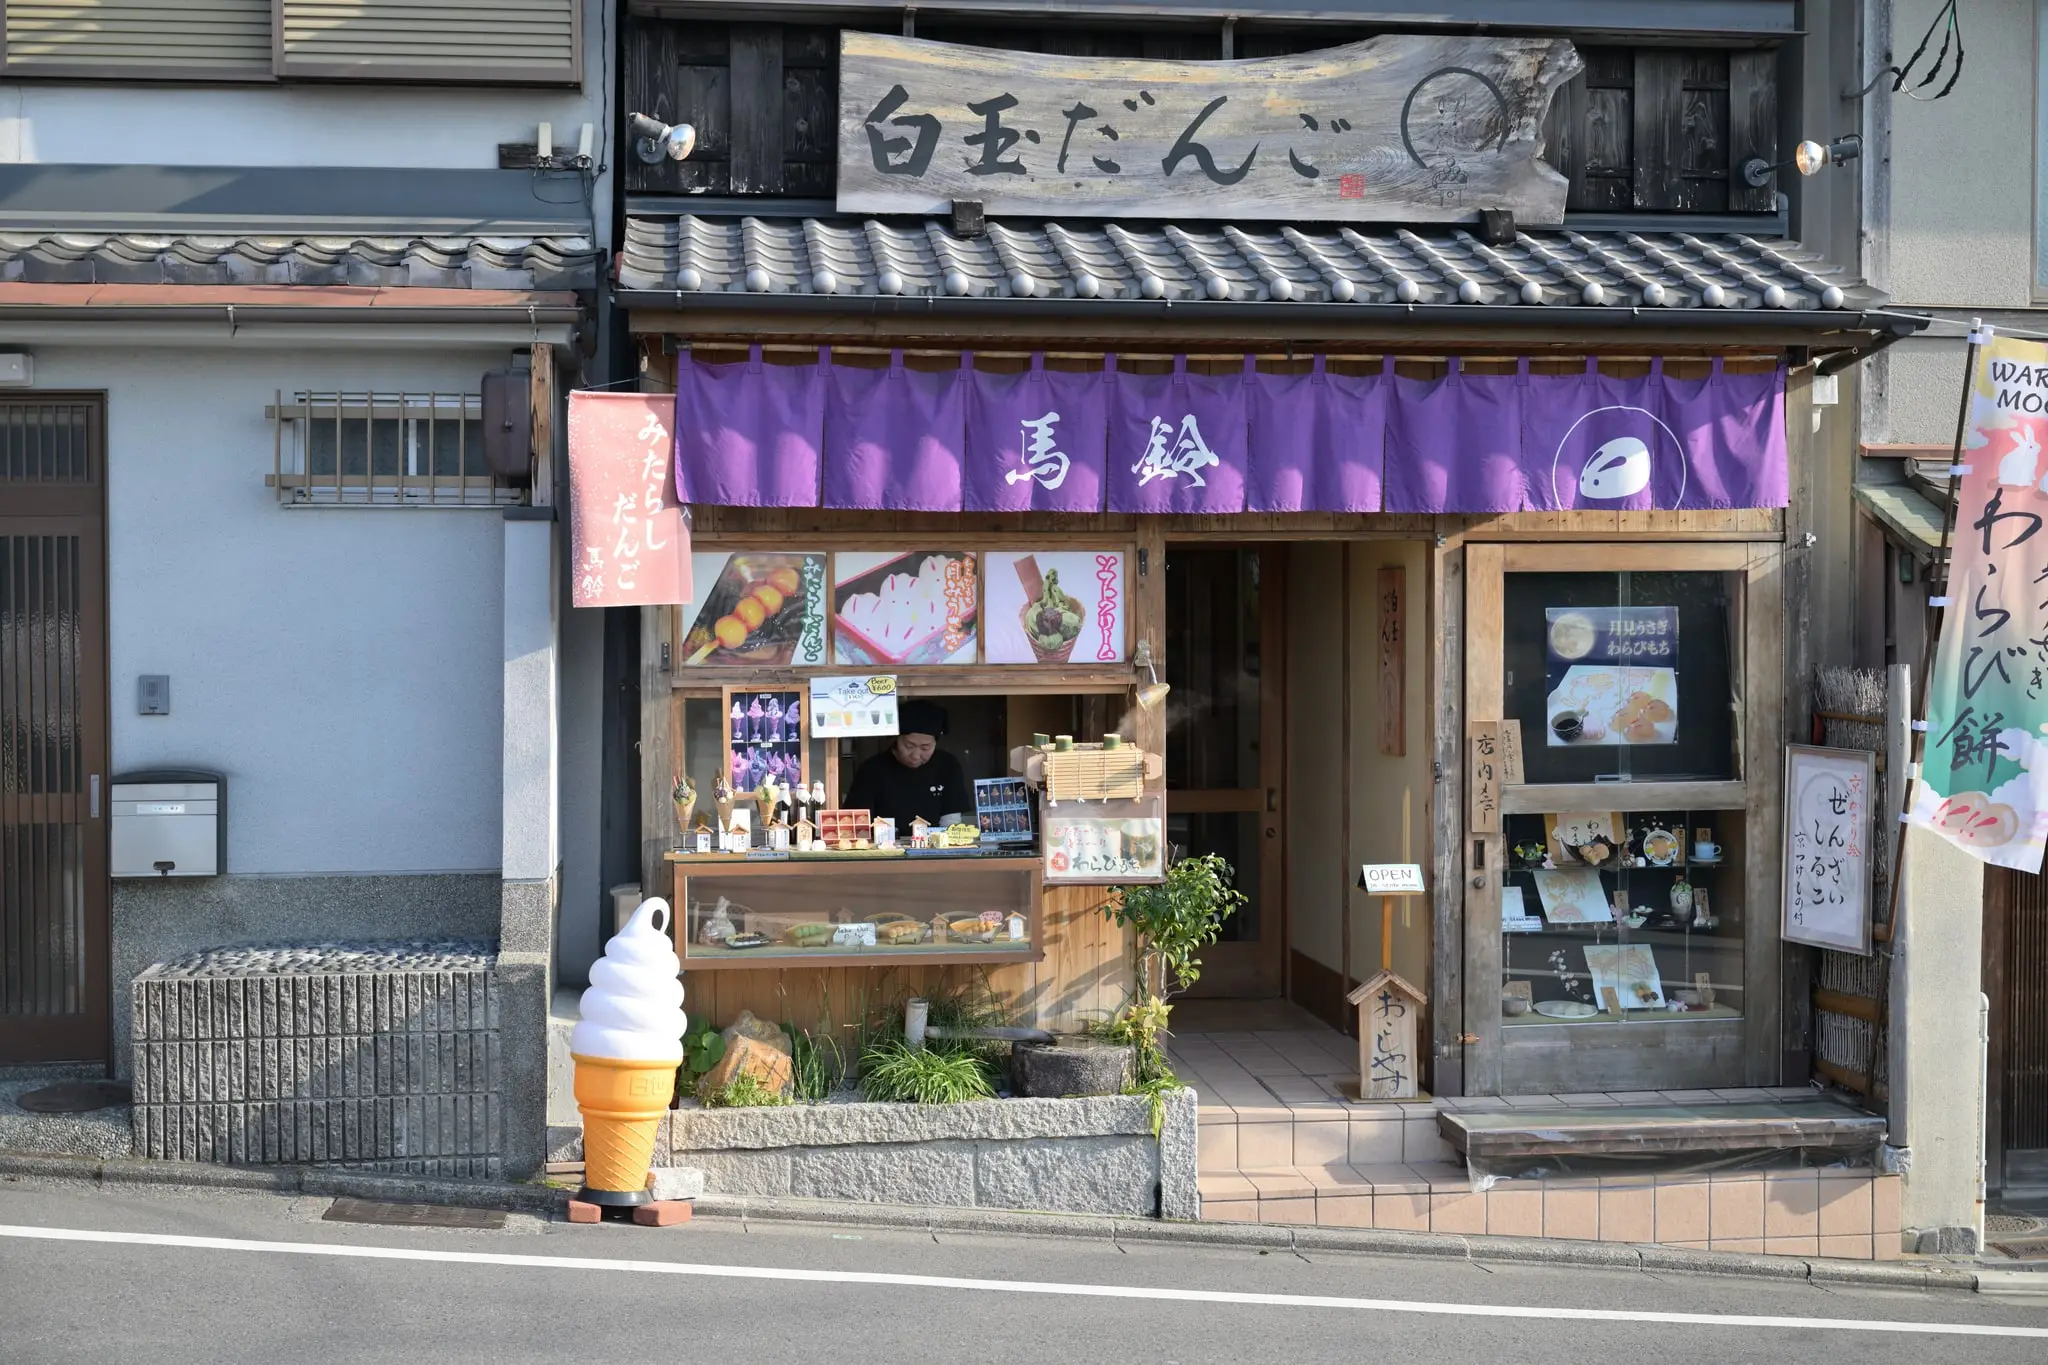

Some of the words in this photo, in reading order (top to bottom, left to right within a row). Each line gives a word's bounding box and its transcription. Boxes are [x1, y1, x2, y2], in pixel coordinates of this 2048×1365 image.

[864, 84, 1352, 186] 白玉だんご
[1997, 389, 2048, 414] MO
[638, 412, 668, 550] みたらし
[613, 492, 640, 590] だんご
[1607, 640, 1670, 656] わらびもち
[1609, 619, 1669, 636] 月見うさぎ
[1936, 487, 2043, 784] わらび餅
[1477, 734, 1496, 825] 店内メニュー
[1369, 869, 1412, 881] OPEN
[1811, 819, 1827, 906] しるこ
[1828, 786, 1850, 905] ぜんざい
[1371, 990, 1408, 1095] おこしやす
